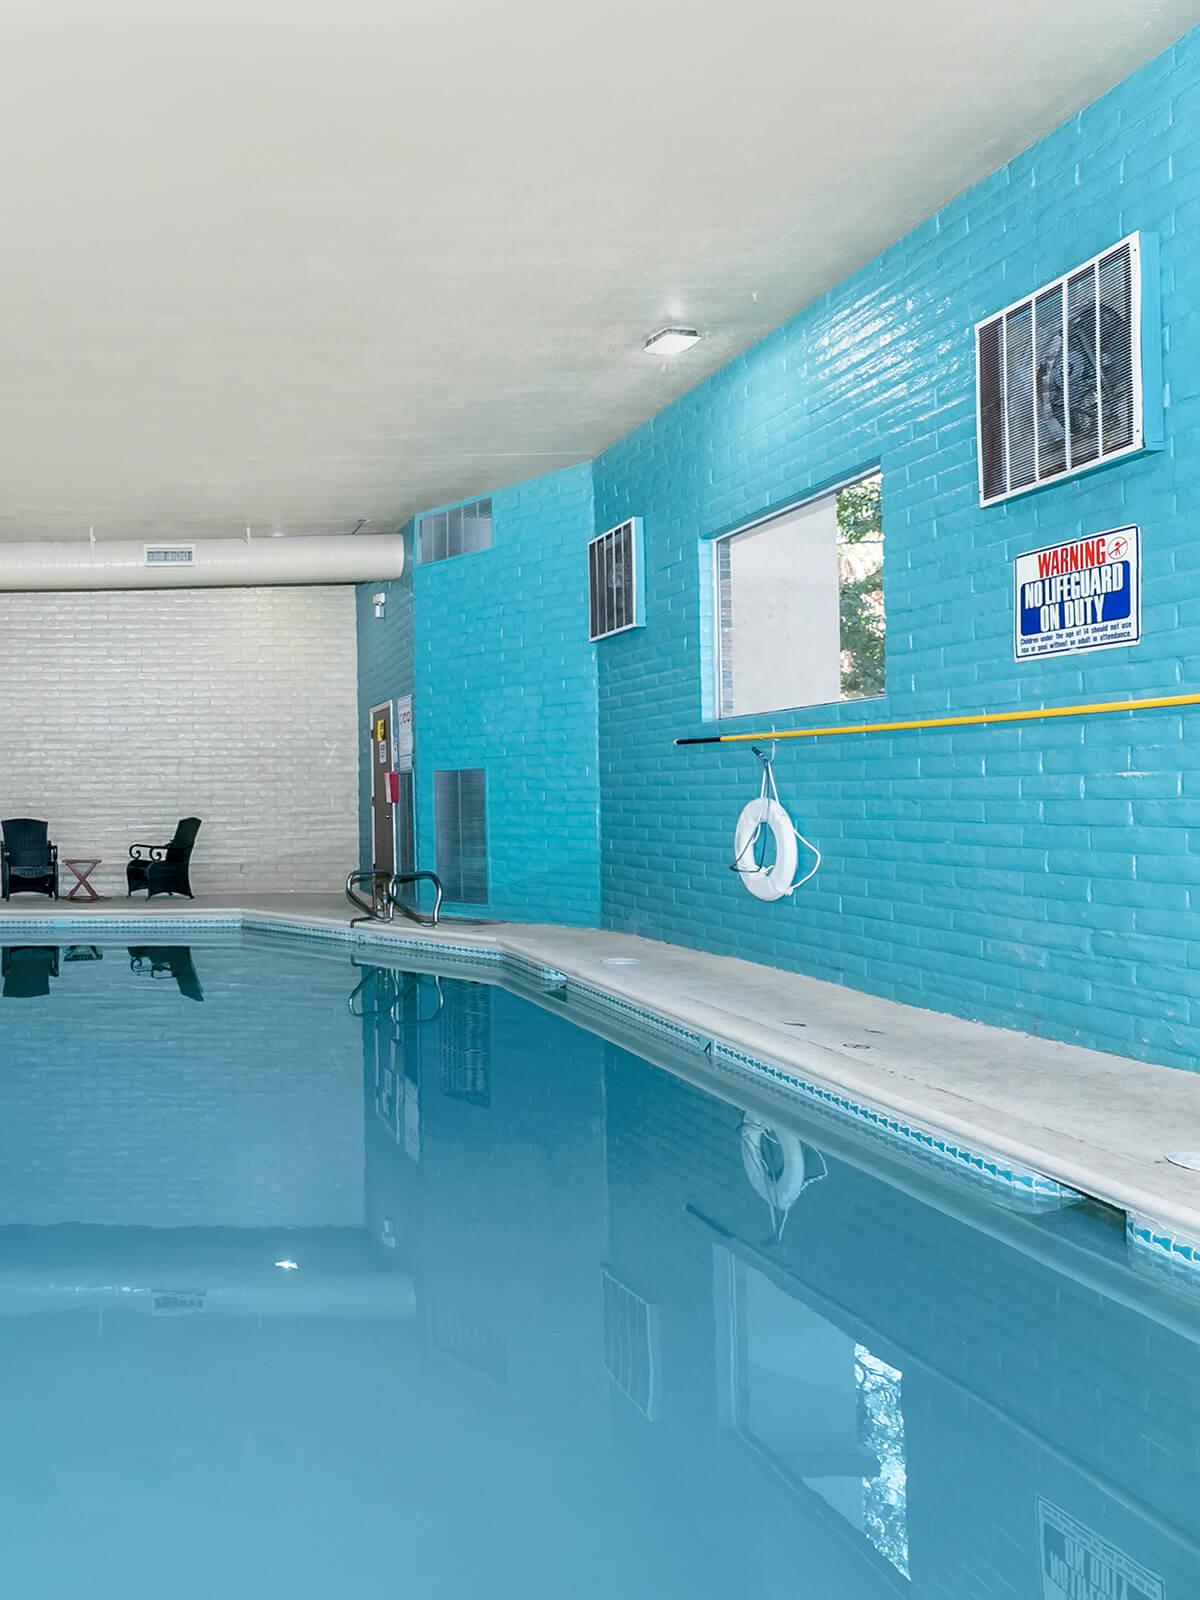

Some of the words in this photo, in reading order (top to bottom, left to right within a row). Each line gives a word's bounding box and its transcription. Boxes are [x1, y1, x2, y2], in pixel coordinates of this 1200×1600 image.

[1037, 538, 1106, 579] WARNING
[1024, 581, 1043, 610] NO
[1044, 562, 1124, 605] LIFEGUARD
[1040, 603, 1060, 632] ON
[1064, 594, 1105, 627] DUTY
